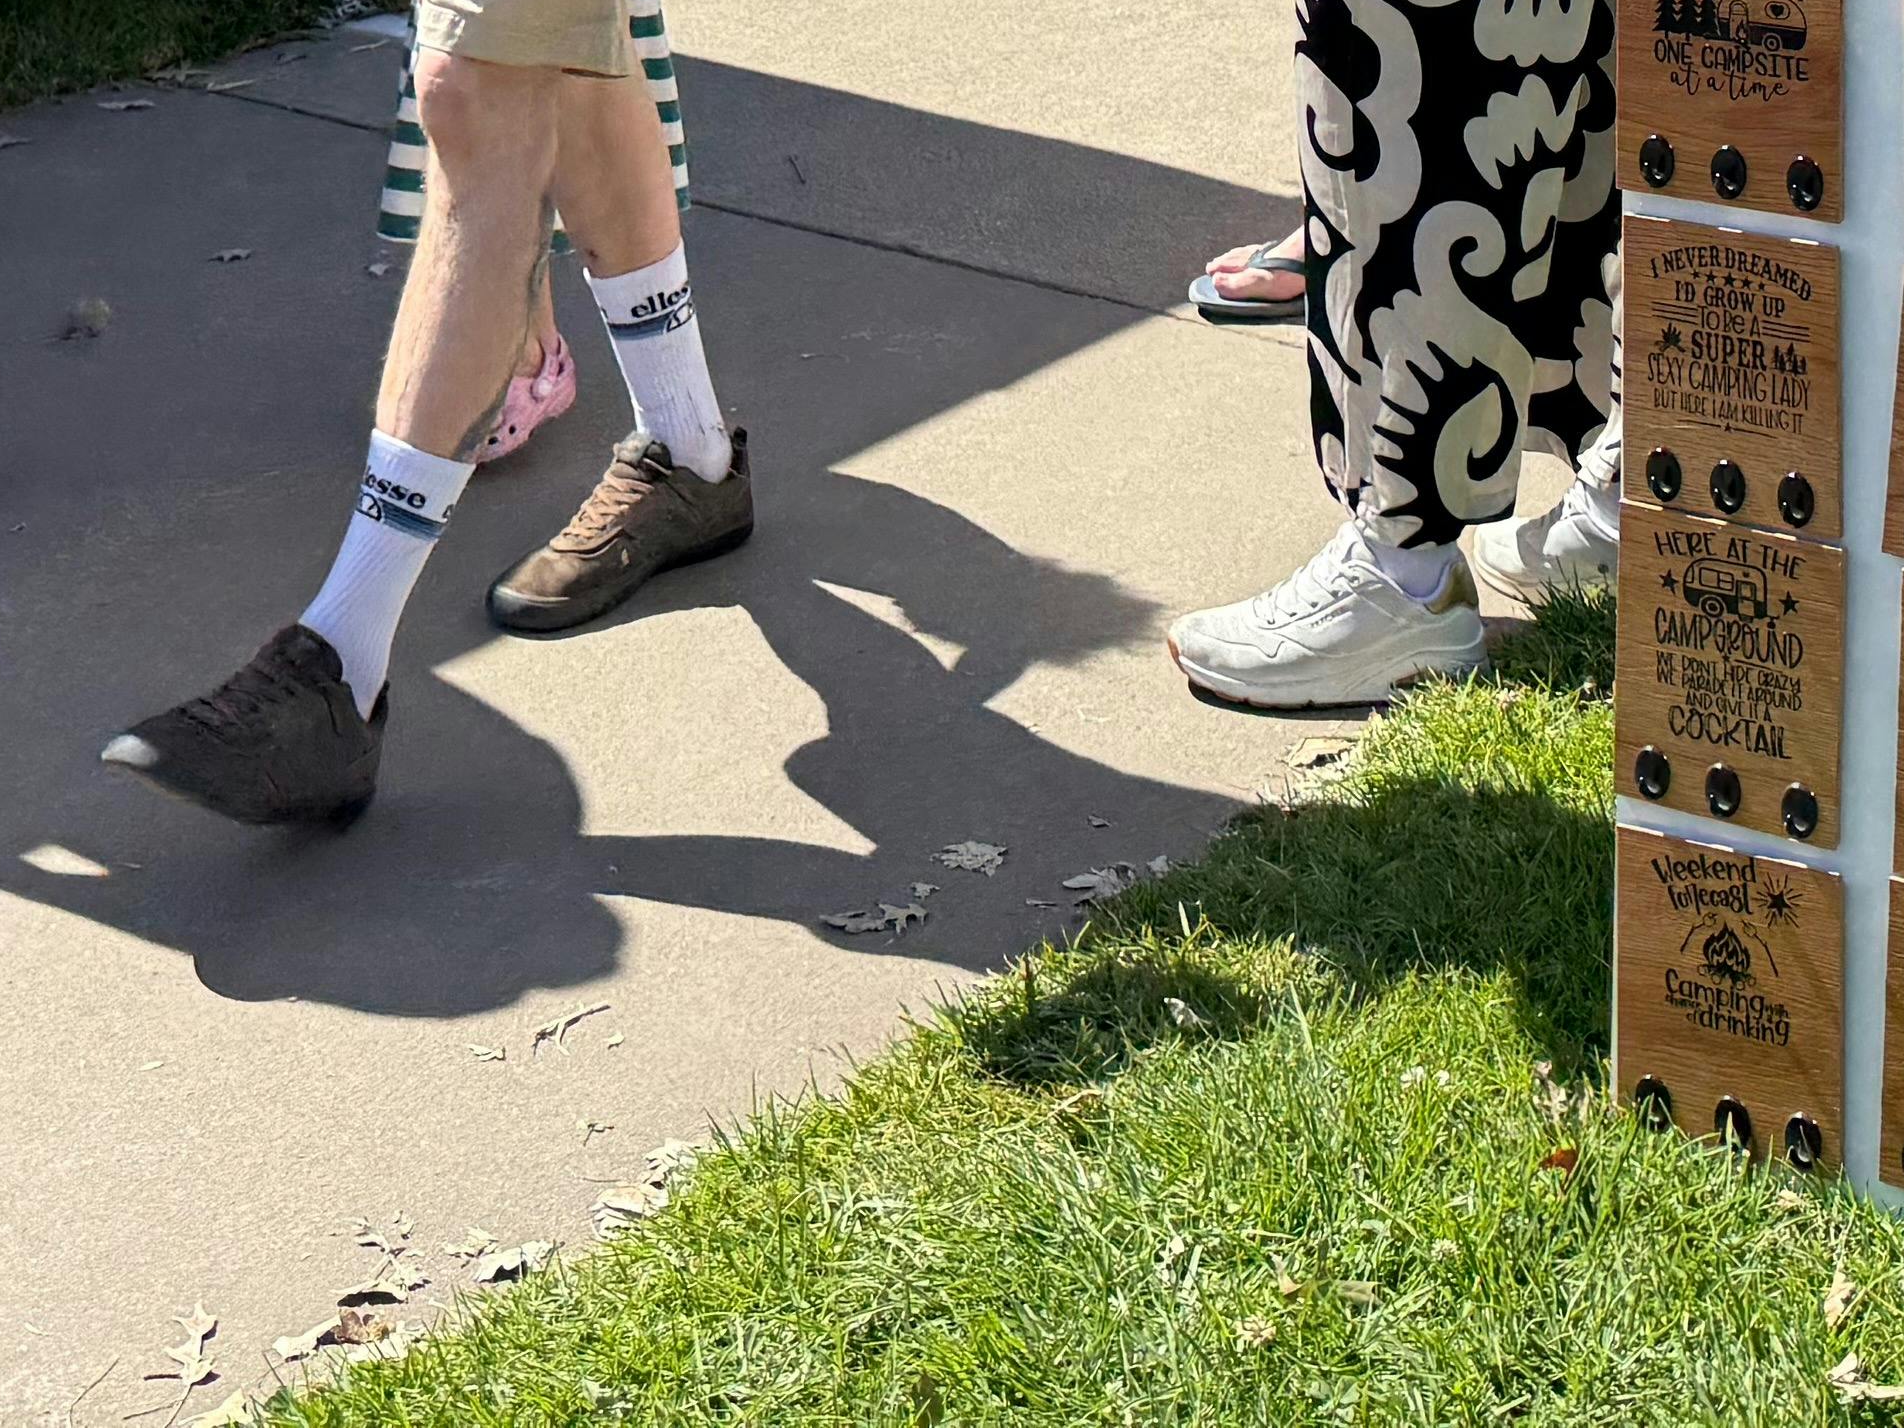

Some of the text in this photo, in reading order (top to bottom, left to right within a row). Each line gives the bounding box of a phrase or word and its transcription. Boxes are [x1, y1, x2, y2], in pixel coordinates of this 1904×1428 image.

[1654, 38, 1810, 82] ONE CAMPSITE
[1670, 62, 1790, 103] at a time
[1650, 245, 1813, 302] I NEVER DREAMED
[1703, 285, 1755, 313] GROW
[1762, 294, 1786, 318] UP
[1749, 314, 1761, 339] A
[1691, 329, 1767, 372] SUPER
[1647, 352, 1811, 412] SEXY CAMPING LADY
[1653, 387, 1677, 410] BUT
[1680, 391, 1709, 417] HERE
[1718, 399, 1739, 423] AM
[1741, 403, 1790, 432] KILLING
[1790, 412, 1804, 436] IT
[1653, 530, 1807, 581] HERE AT THE
[1654, 605, 1804, 670] CAMPGROUND
[1656, 650, 1677, 670] WE
[1758, 669, 1801, 694] CRAZY
[1656, 666, 1803, 712] WE PARADE IT AROUND
[1685, 690, 1713, 711] AND
[1715, 695, 1746, 718] GIVE
[1763, 704, 1773, 724] A
[1668, 705, 1793, 760] COCKTAIL
[1651, 853, 1757, 885] Weekend
[1665, 967, 1766, 1020] Camping
[1698, 1003, 1791, 1047] drinking
